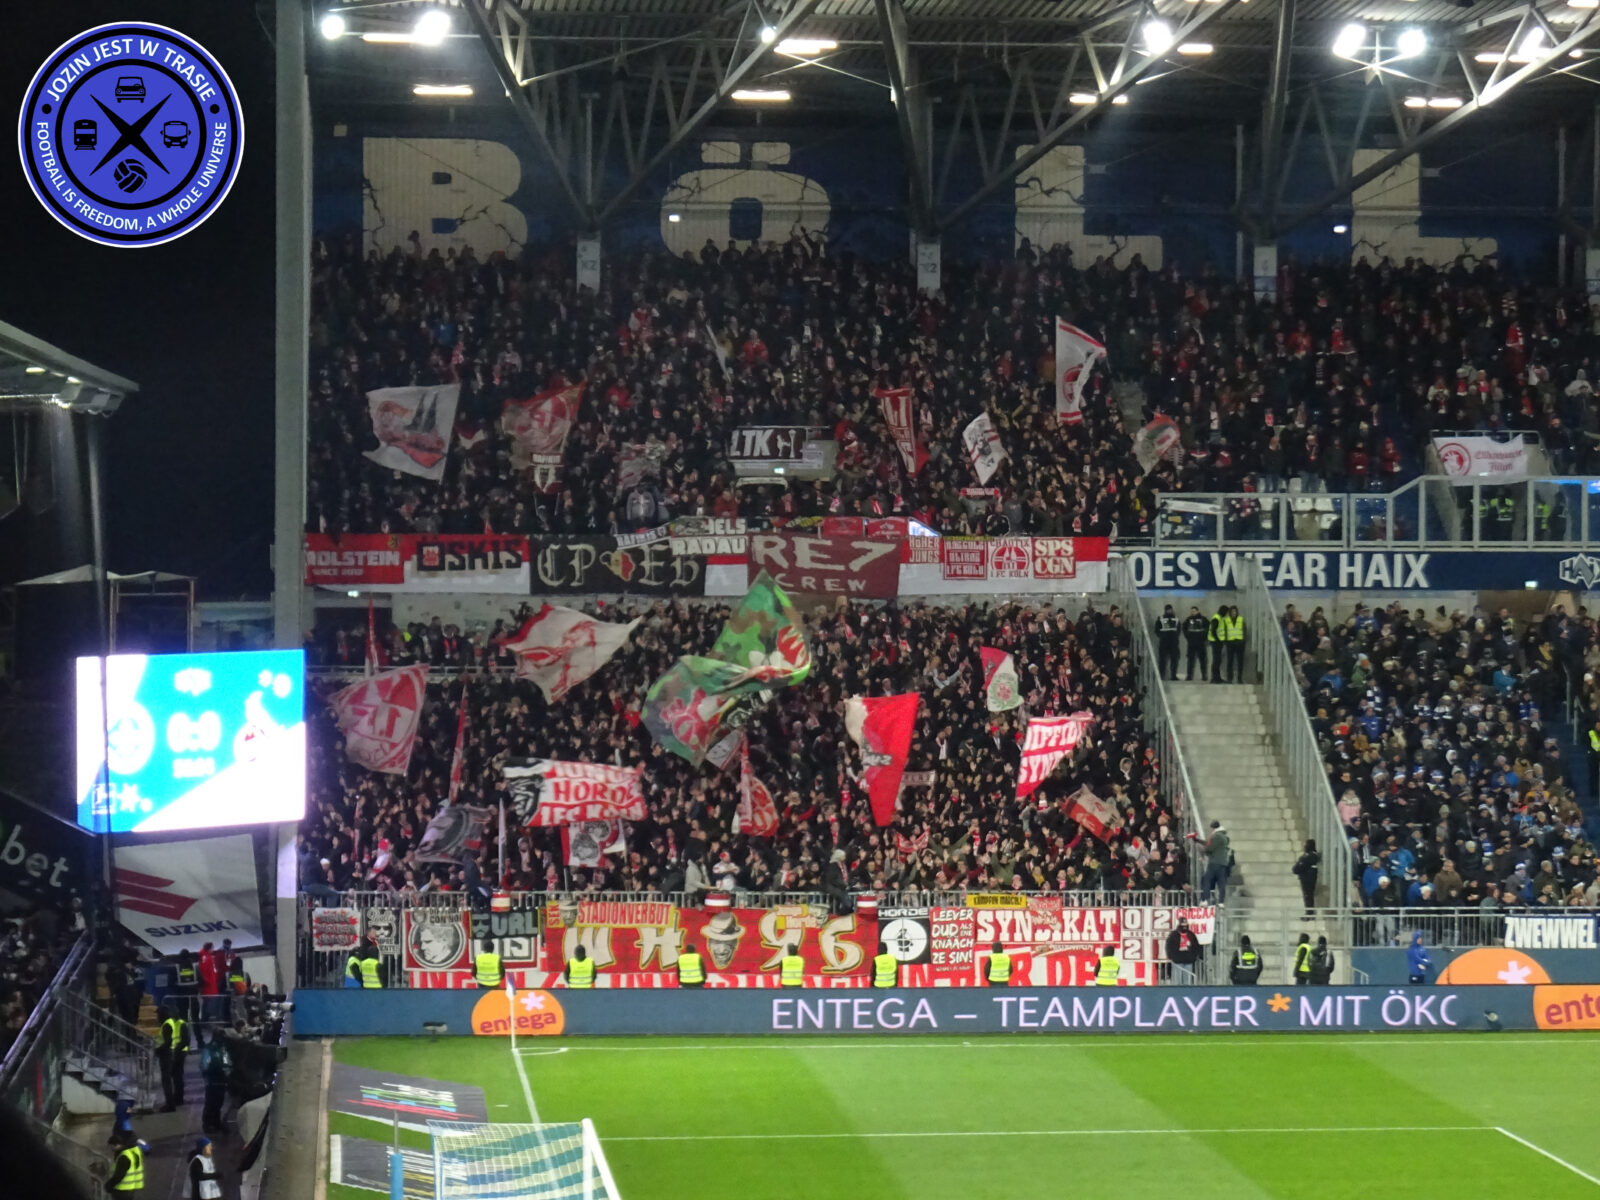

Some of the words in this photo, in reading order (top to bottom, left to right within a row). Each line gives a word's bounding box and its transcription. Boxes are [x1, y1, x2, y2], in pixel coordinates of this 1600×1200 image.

[729, 429, 774, 457] LTK
[671, 537, 746, 556] RADAU
[1034, 538, 1074, 556] SPS
[1034, 557, 1074, 574] CGN
[1108, 551, 1200, 588] OES
[1339, 552, 1430, 588] HAIX
[775, 573, 866, 591] CREW
[578, 902, 671, 924] STADIONVERBOT
[878, 908, 929, 917] HORDE
[932, 908, 974, 922] LEEVER
[144, 920, 239, 938] SUZUKI
[932, 923, 959, 937] DUD
[932, 936, 974, 950] KNÄÄCH
[932, 951, 946, 964] ZE
[948, 949, 973, 964] SIN!
[772, 997, 938, 1029] ENTEGA
[993, 995, 1259, 1028] TEAMPLAYER
[1301, 995, 1370, 1026] MIT
